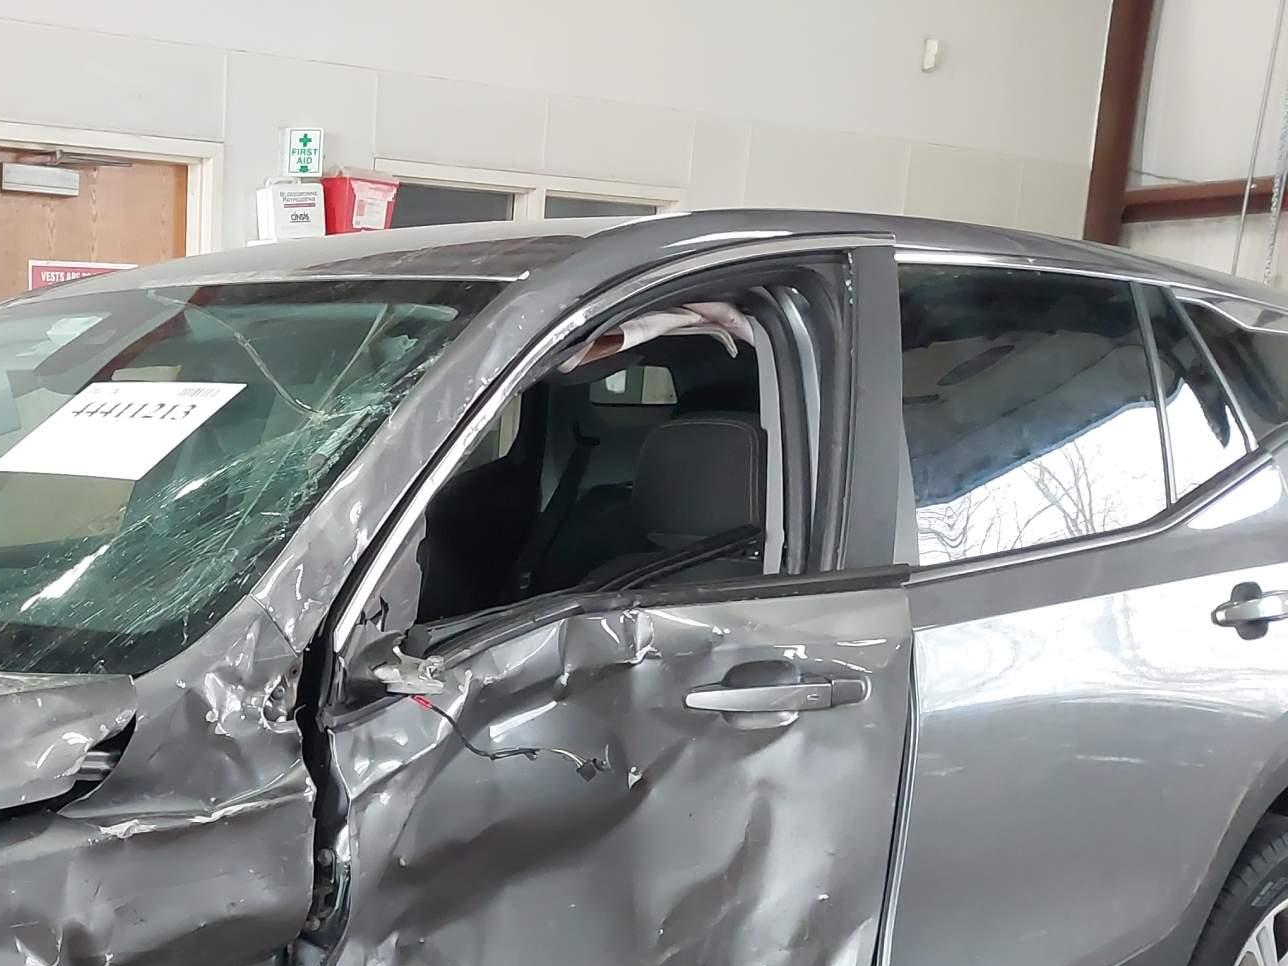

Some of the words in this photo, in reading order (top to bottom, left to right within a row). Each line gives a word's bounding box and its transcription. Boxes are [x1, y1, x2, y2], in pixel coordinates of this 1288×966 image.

[292, 148, 318, 156] FIRST
[296, 156, 313, 165] AID
[41, 271, 65, 282] VESTS
[71, 401, 198, 421] 44411213
